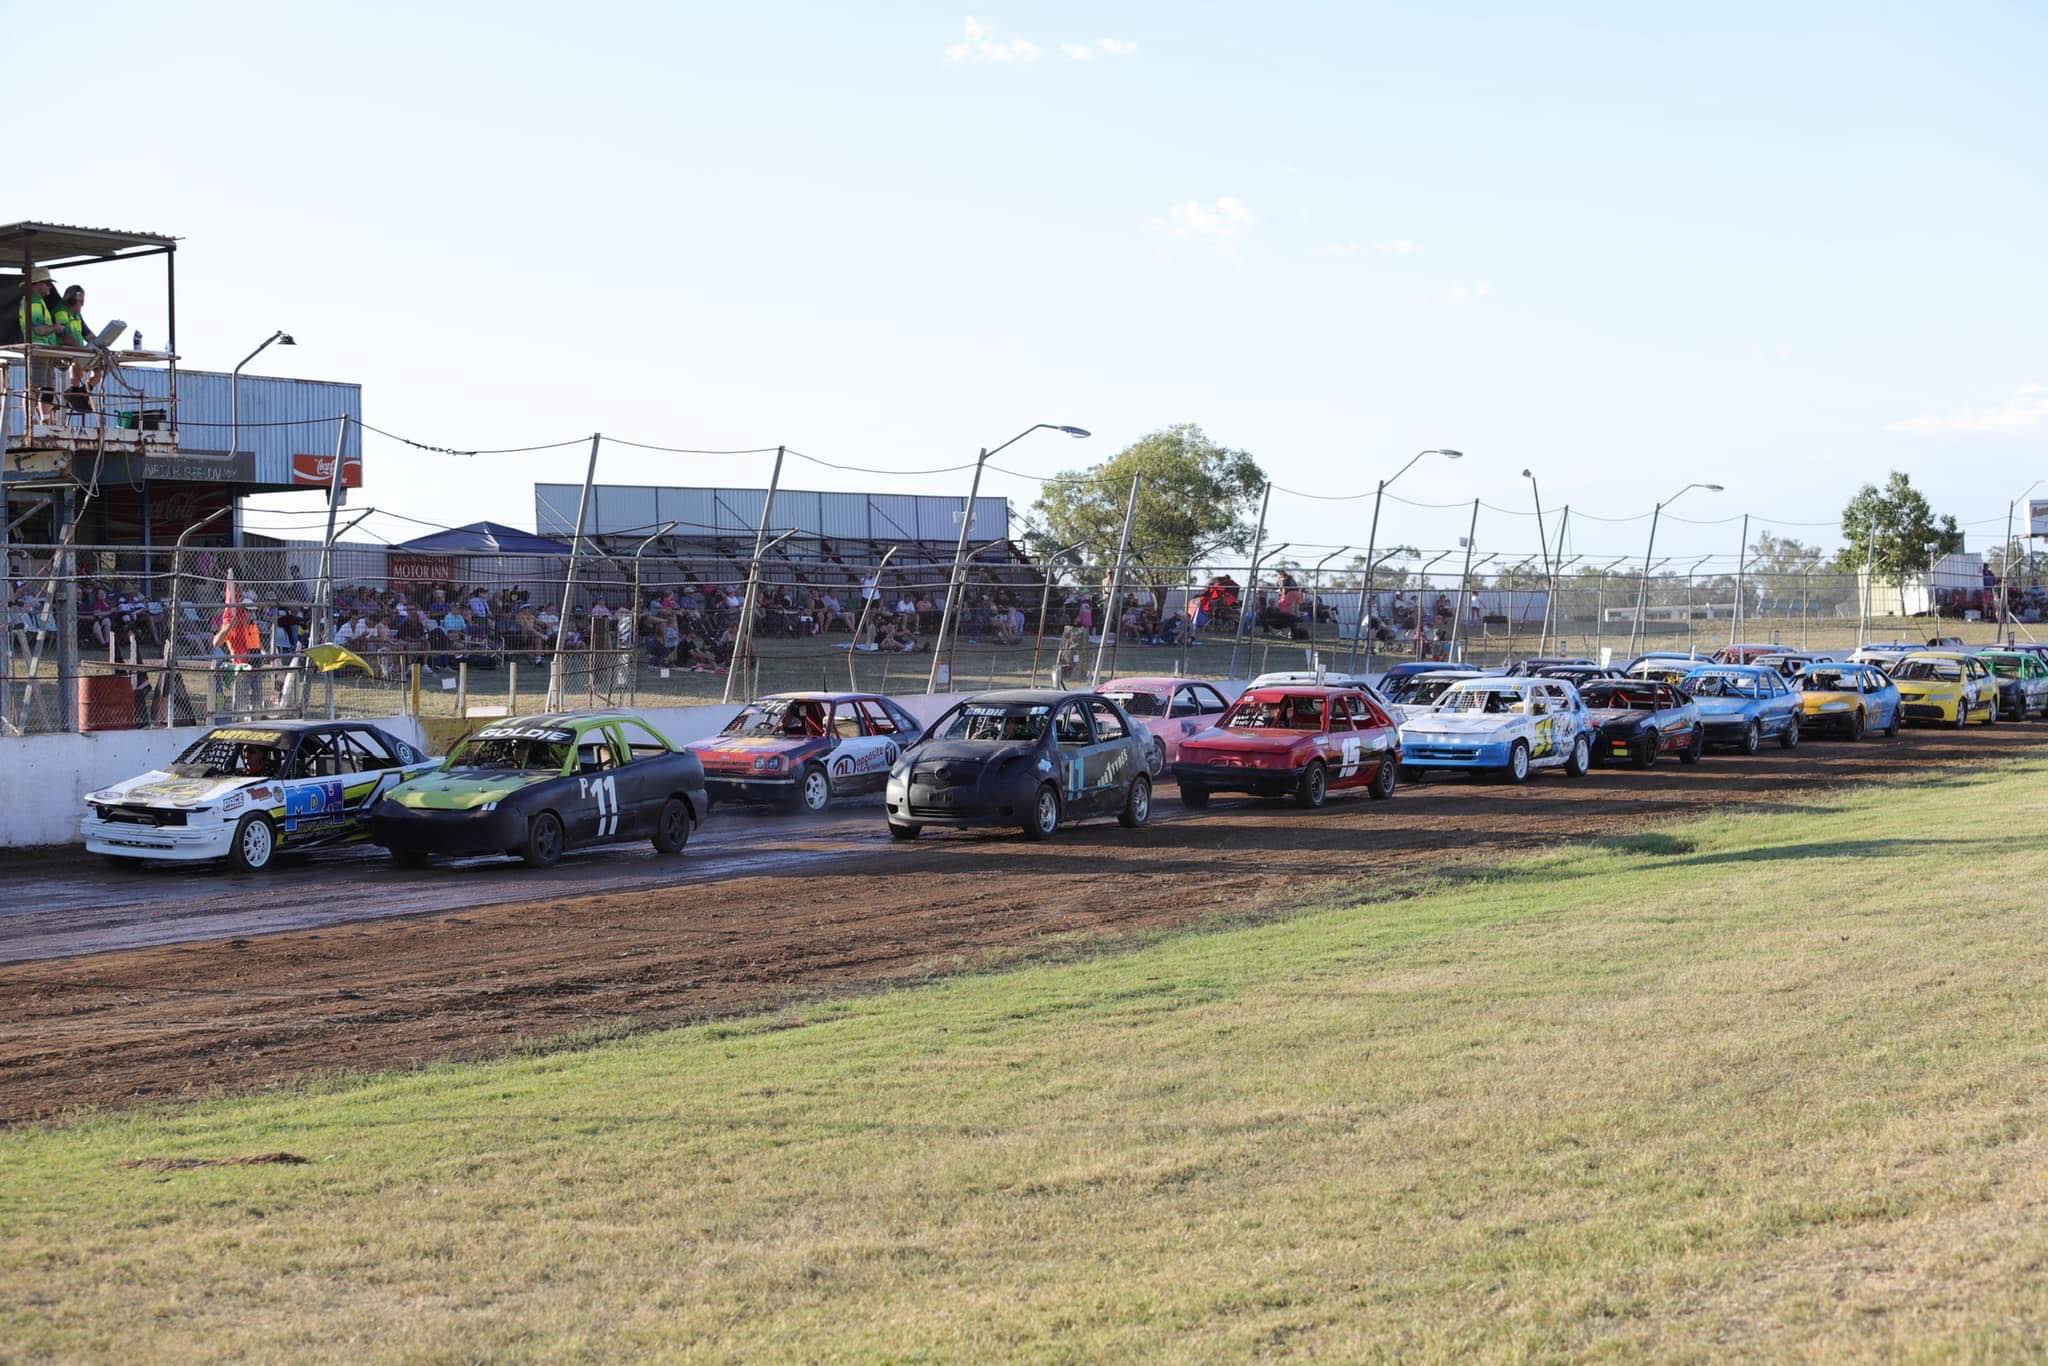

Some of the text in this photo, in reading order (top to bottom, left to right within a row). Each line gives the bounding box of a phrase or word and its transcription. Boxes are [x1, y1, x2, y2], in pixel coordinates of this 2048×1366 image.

[393, 564, 449, 579] MOTOR INN
[964, 708, 1006, 717] GOLDIE
[478, 726, 572, 741] GOLDIE
[1337, 736, 1361, 778] 15
[223, 793, 245, 809] PACE
[284, 779, 345, 832] MDH
